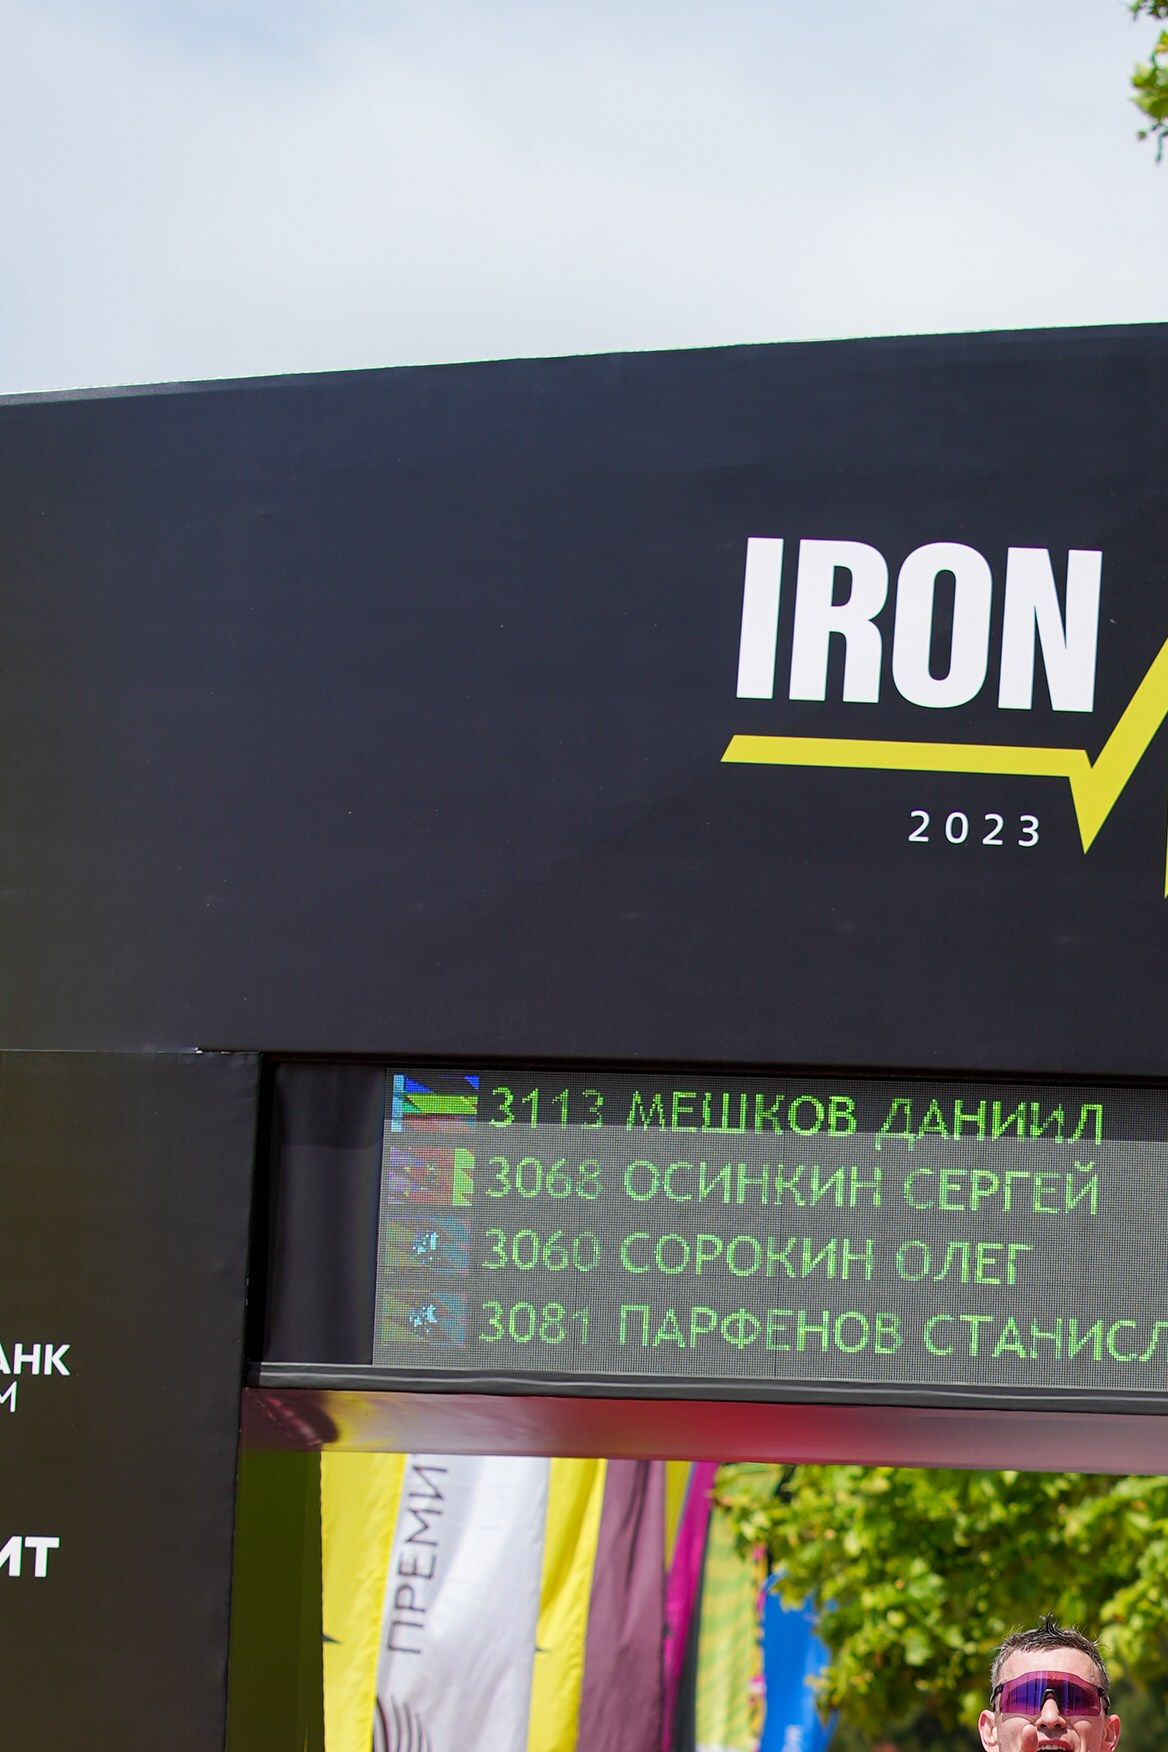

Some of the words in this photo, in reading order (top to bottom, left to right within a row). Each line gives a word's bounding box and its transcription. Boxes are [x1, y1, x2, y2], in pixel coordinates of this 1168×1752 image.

[736, 537, 1103, 713] IRON
[908, 810, 1042, 848] 2023
[489, 1087, 604, 1130] 3113
[626, 1091, 858, 1138] МЕШКОВ
[875, 1098, 1104, 1151] ДАНИИЛ
[486, 1155, 603, 1200] 3068
[623, 1159, 884, 1208] ОСИНКИН
[903, 1161, 1099, 1215] СЕРГЕЙ
[483, 1227, 601, 1273] 3060
[620, 1232, 875, 1281] СОРОКИН
[895, 1240, 1034, 1286] ОЛЕГ
[479, 1300, 590, 1345] 3081
[619, 1304, 904, 1356] ПАРФЕНОВ
[386, 1453, 447, 1656] ПРЕМИ
